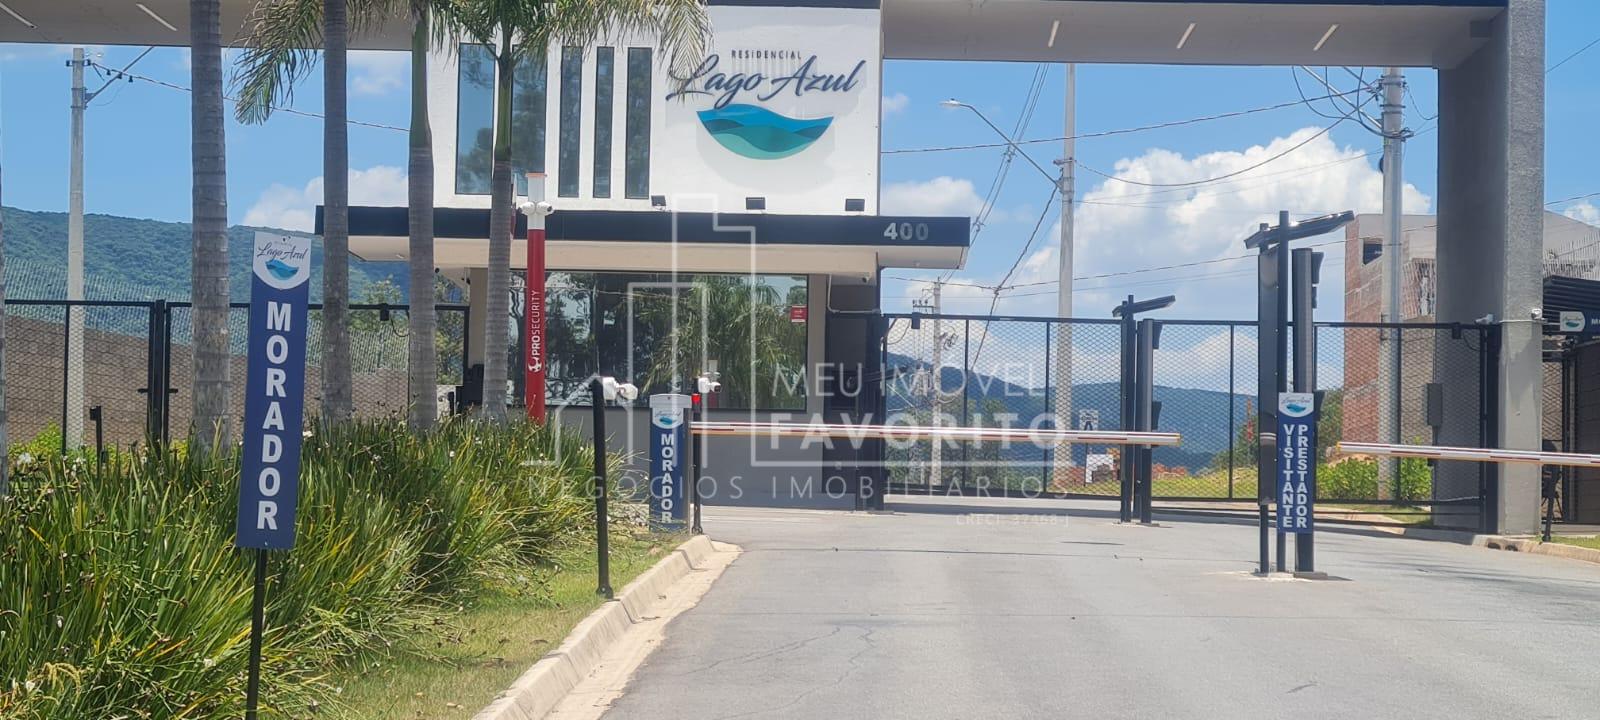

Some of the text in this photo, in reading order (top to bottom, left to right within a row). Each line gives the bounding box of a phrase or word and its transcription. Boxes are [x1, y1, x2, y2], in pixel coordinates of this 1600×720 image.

[665, 54, 866, 109] Lago Azul
[731, 50, 802, 60] RESIDENCIAL
[883, 222, 929, 241] 400
[531, 290, 541, 357] PROSECURITY
[257, 301, 292, 531] MORADOR
[660, 433, 674, 524] MORADOR
[1282, 424, 1295, 528] VISITANTE
[1296, 424, 1309, 528] PRESTADOR
